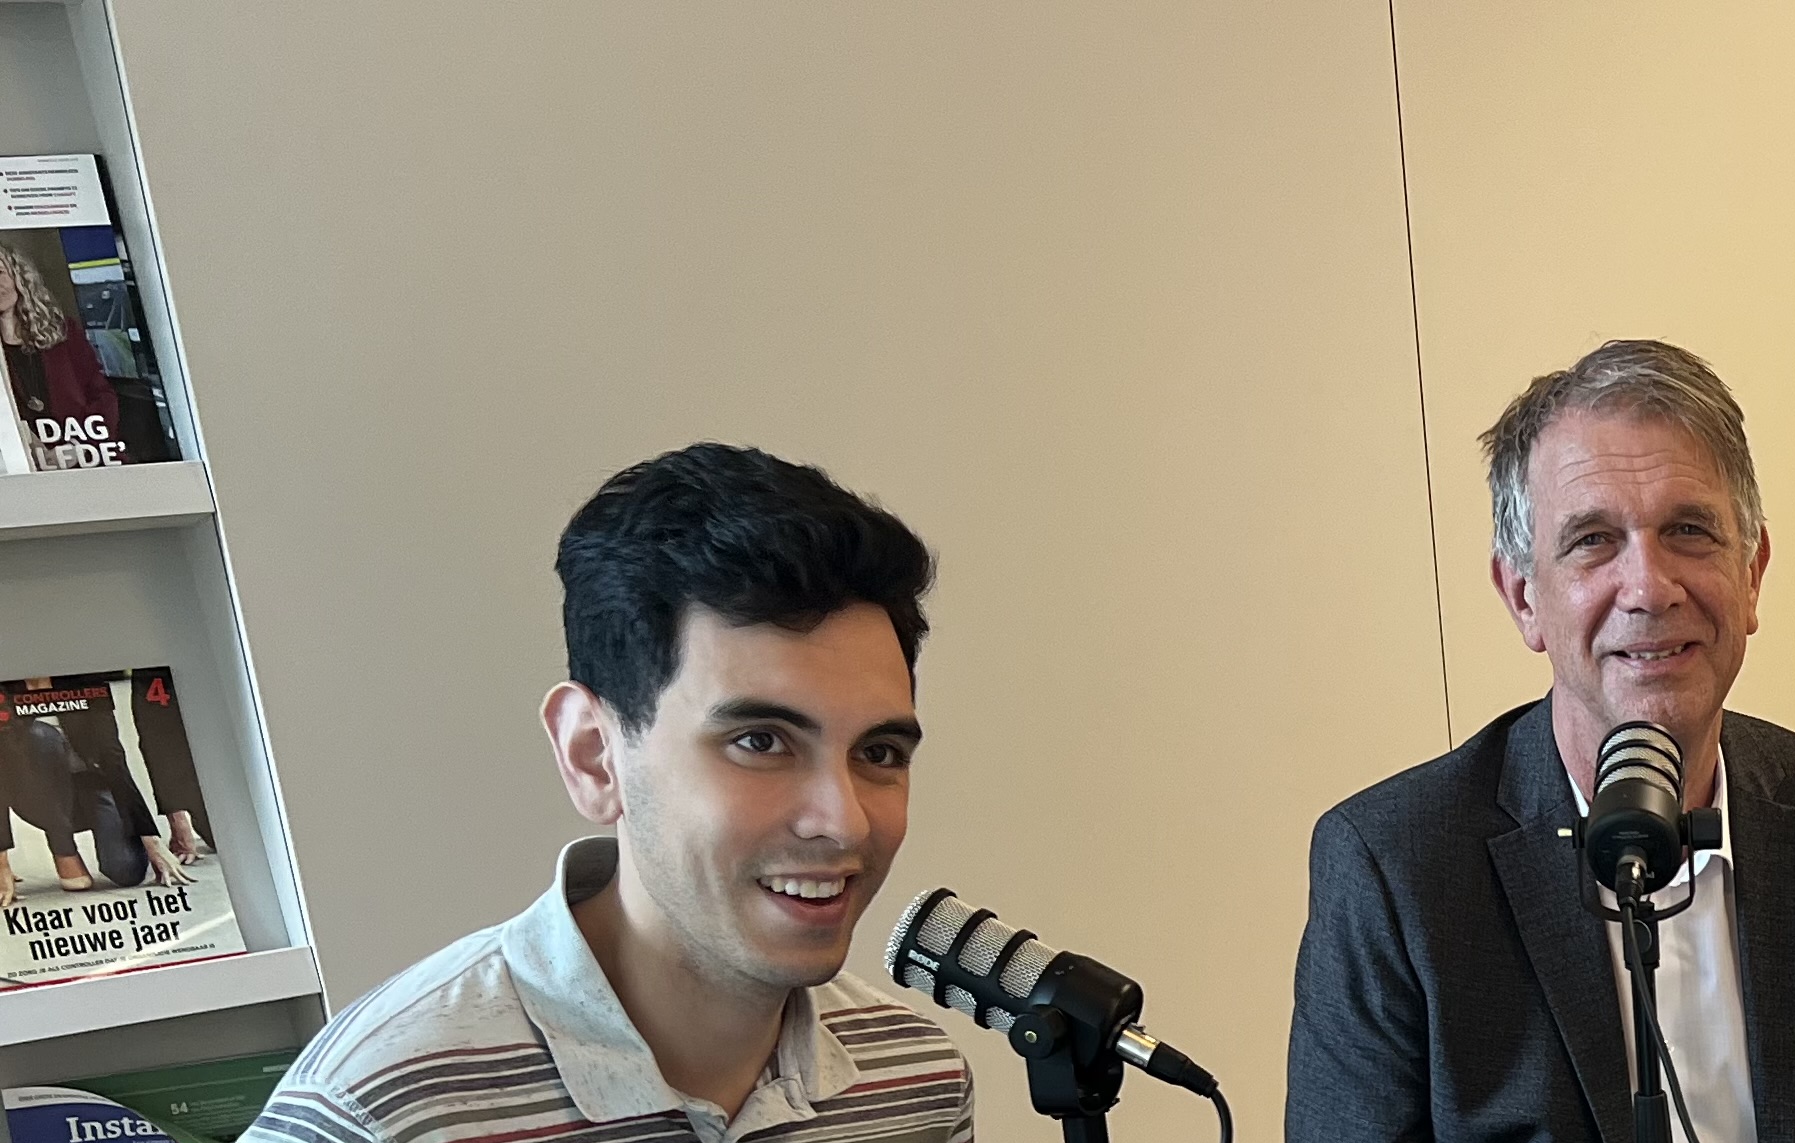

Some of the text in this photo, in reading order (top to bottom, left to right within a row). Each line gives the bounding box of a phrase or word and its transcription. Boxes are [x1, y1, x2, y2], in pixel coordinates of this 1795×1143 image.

[36, 415, 109, 443] DAG
[14, 678, 171, 706] CONTROLLERS 4
[15, 699, 89, 716] MAGAZINE
[3, 886, 192, 936] Klaar voor het
[29, 920, 181, 961] nieuwe jaar
